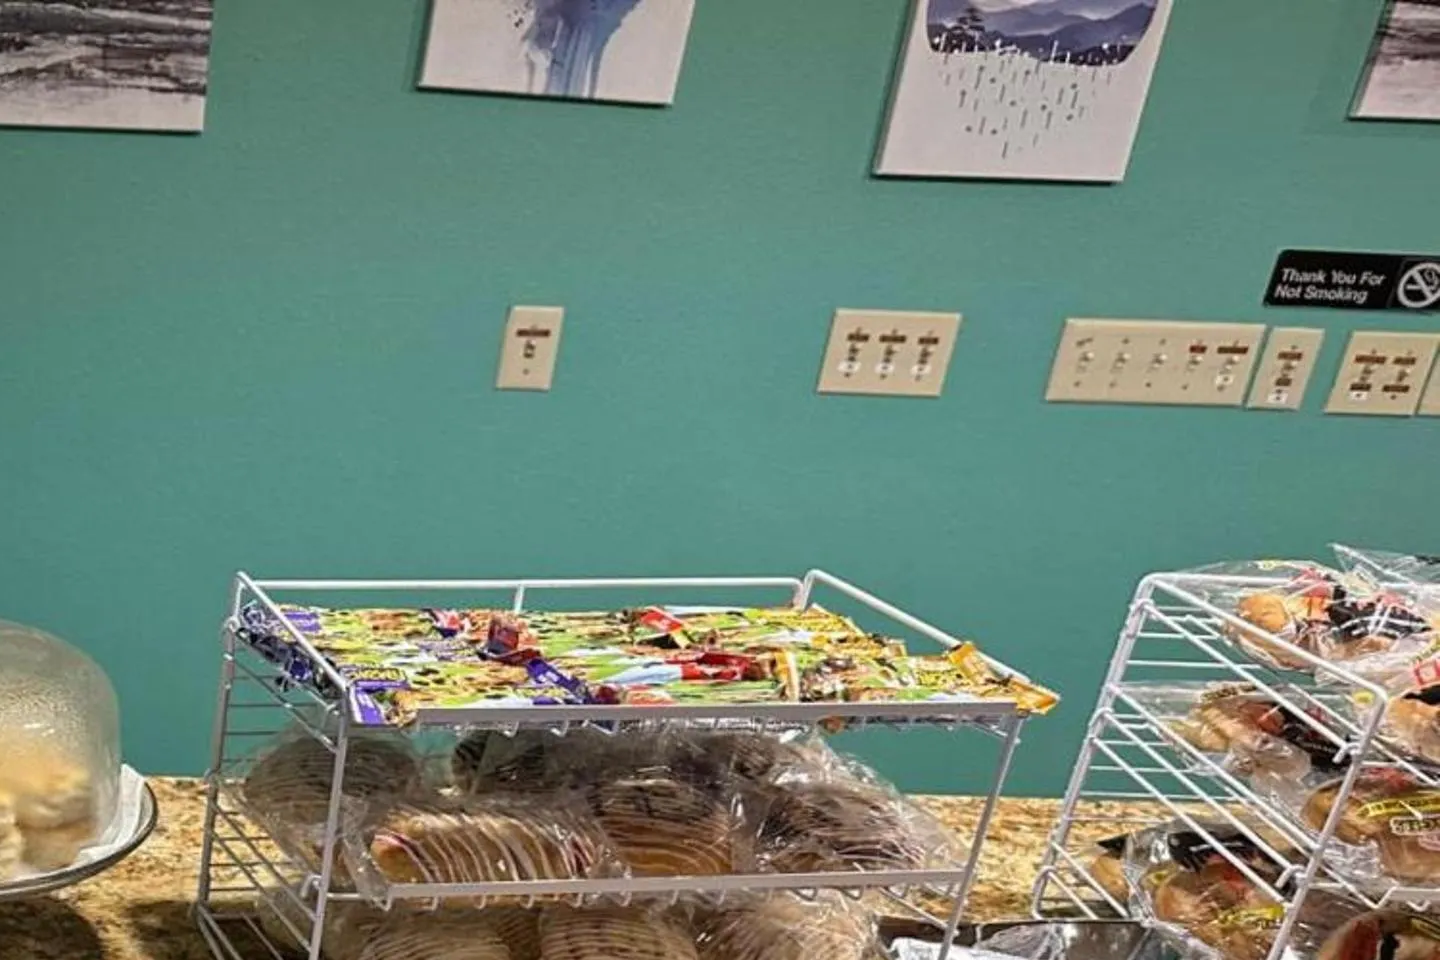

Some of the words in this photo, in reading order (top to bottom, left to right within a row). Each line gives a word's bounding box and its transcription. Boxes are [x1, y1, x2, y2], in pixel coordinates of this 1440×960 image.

[1281, 268, 1327, 283] Thank
[1331, 270, 1357, 285] You
[1360, 271, 1385, 286] For
[1274, 284, 1301, 298] Not
[1304, 285, 1368, 304] Smoking
